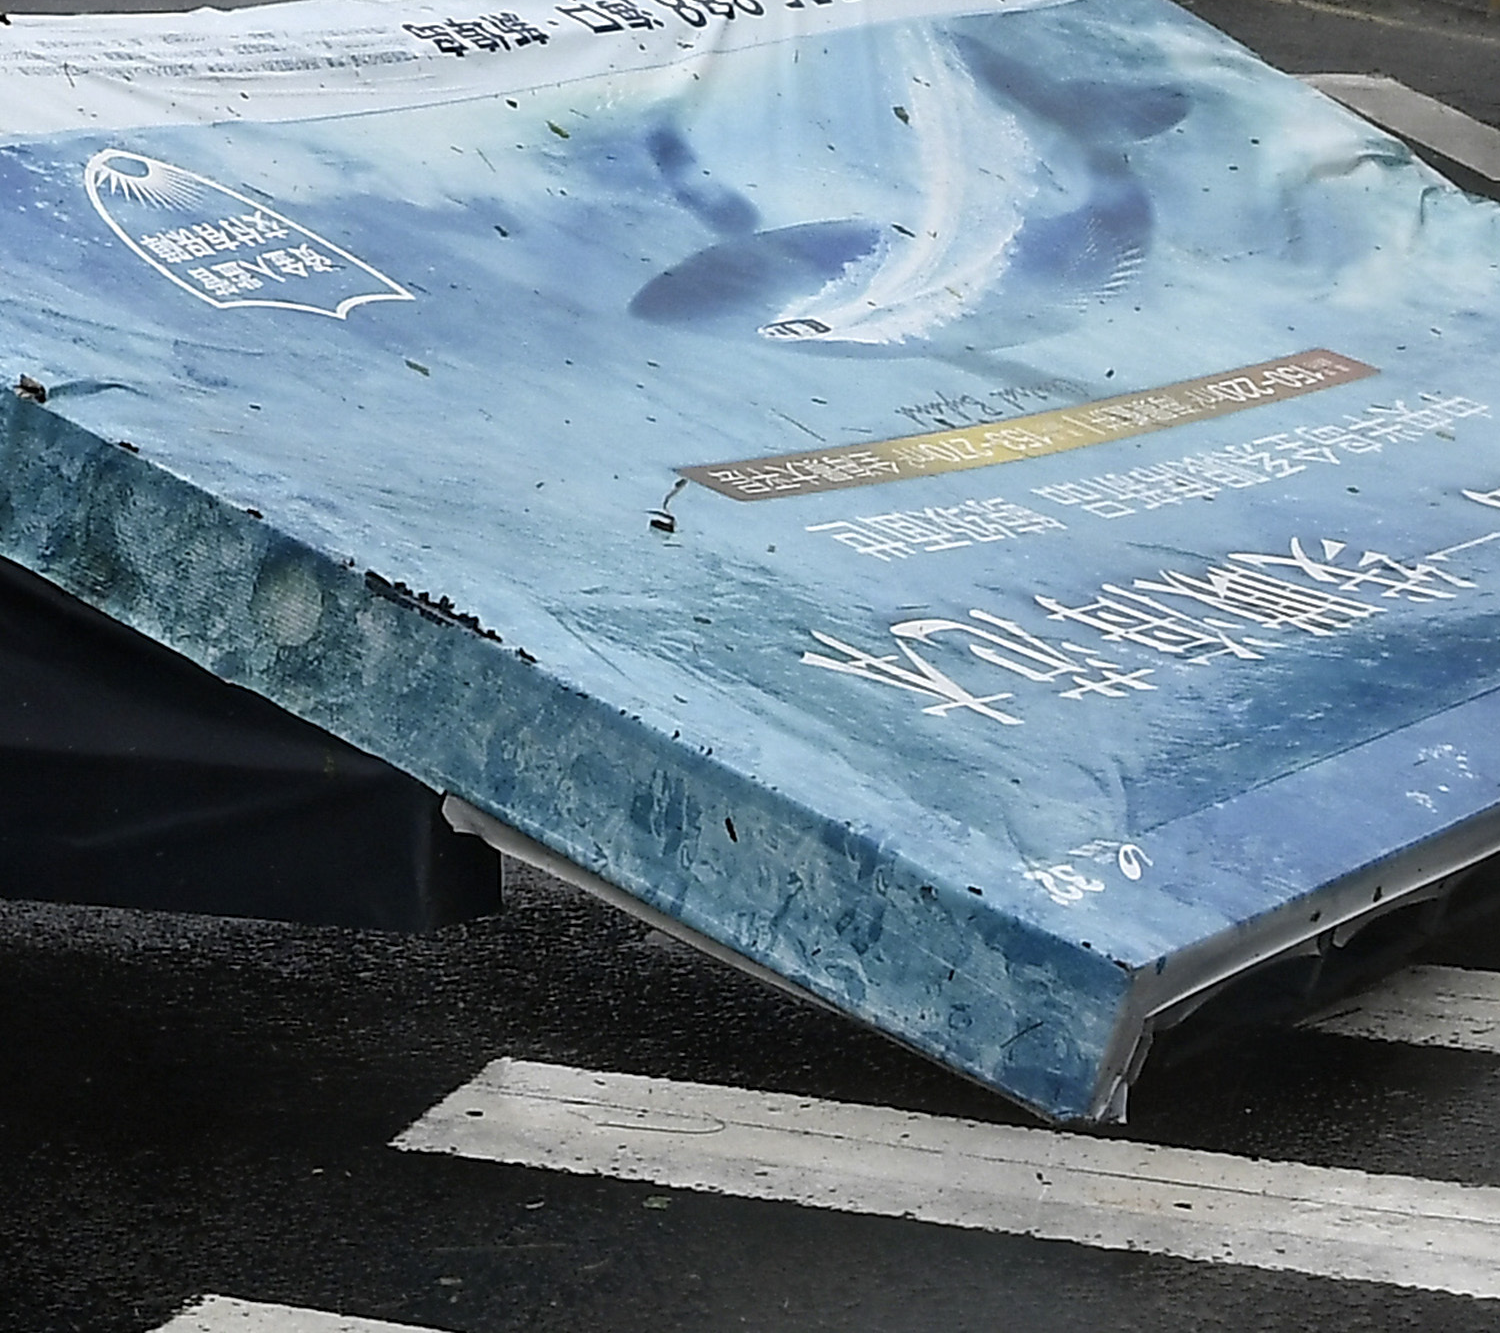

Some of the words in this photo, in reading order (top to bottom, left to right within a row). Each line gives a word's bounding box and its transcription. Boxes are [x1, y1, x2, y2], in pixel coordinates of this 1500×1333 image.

[139, 212, 288, 262] 交付有保障
[189, 245, 337, 296] 资金入监管
